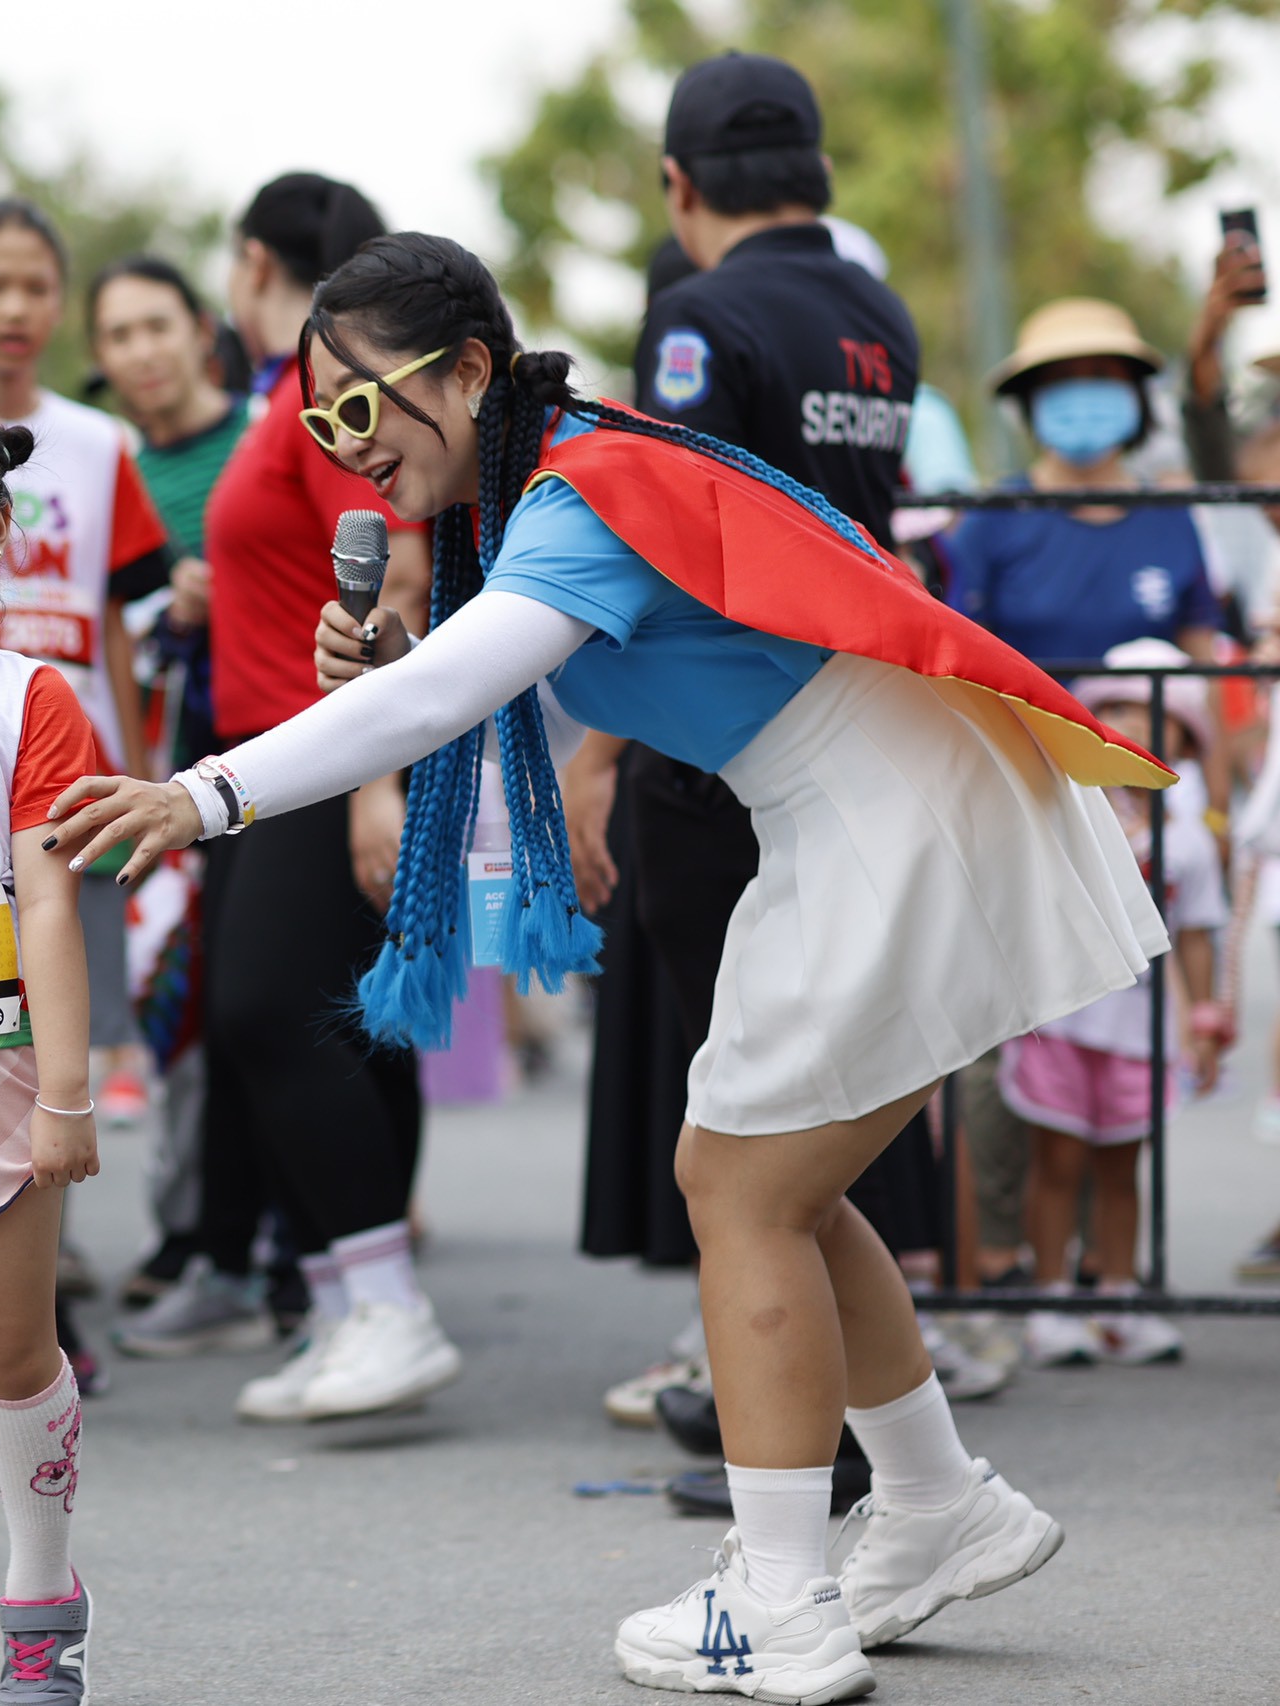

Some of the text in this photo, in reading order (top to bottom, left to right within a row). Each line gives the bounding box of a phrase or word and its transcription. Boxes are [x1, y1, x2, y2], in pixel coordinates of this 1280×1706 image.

[839, 338, 892, 394] TVS
[14, 491, 68, 529] DS
[696, 1590, 753, 1676] LA
